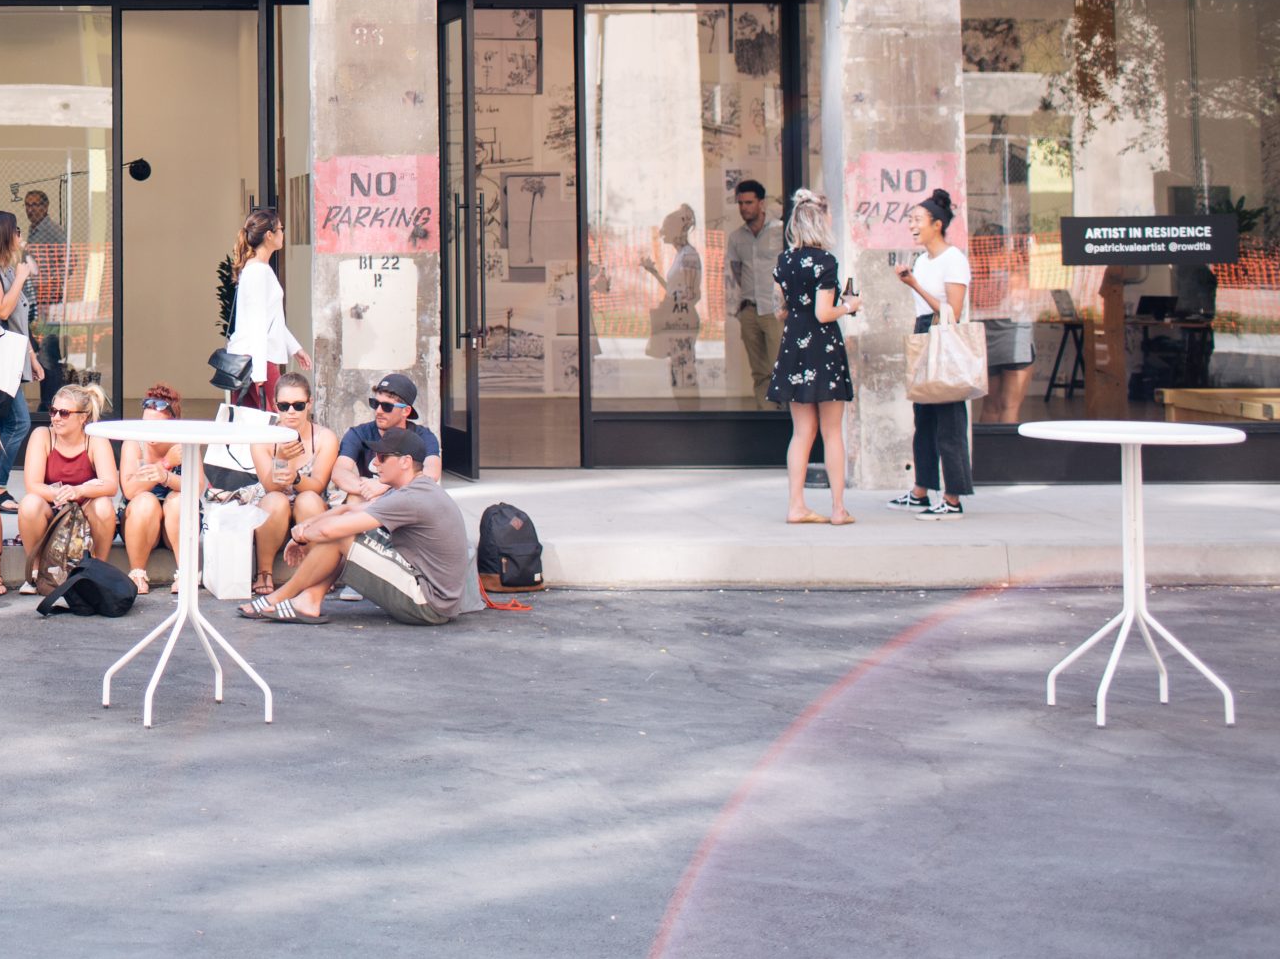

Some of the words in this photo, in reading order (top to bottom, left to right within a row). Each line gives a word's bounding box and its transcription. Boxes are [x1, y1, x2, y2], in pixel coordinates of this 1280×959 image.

[350, 172, 397, 197] NO
[880, 168, 927, 193] NO
[322, 206, 432, 229] PARKING
[1085, 227, 1126, 239] ARTIST
[1128, 227, 1142, 238] IN
[1144, 226, 1212, 238] RESIDENCE
[1168, 241, 1212, 253] @rowdtla
[381, 255, 401, 270] 22
